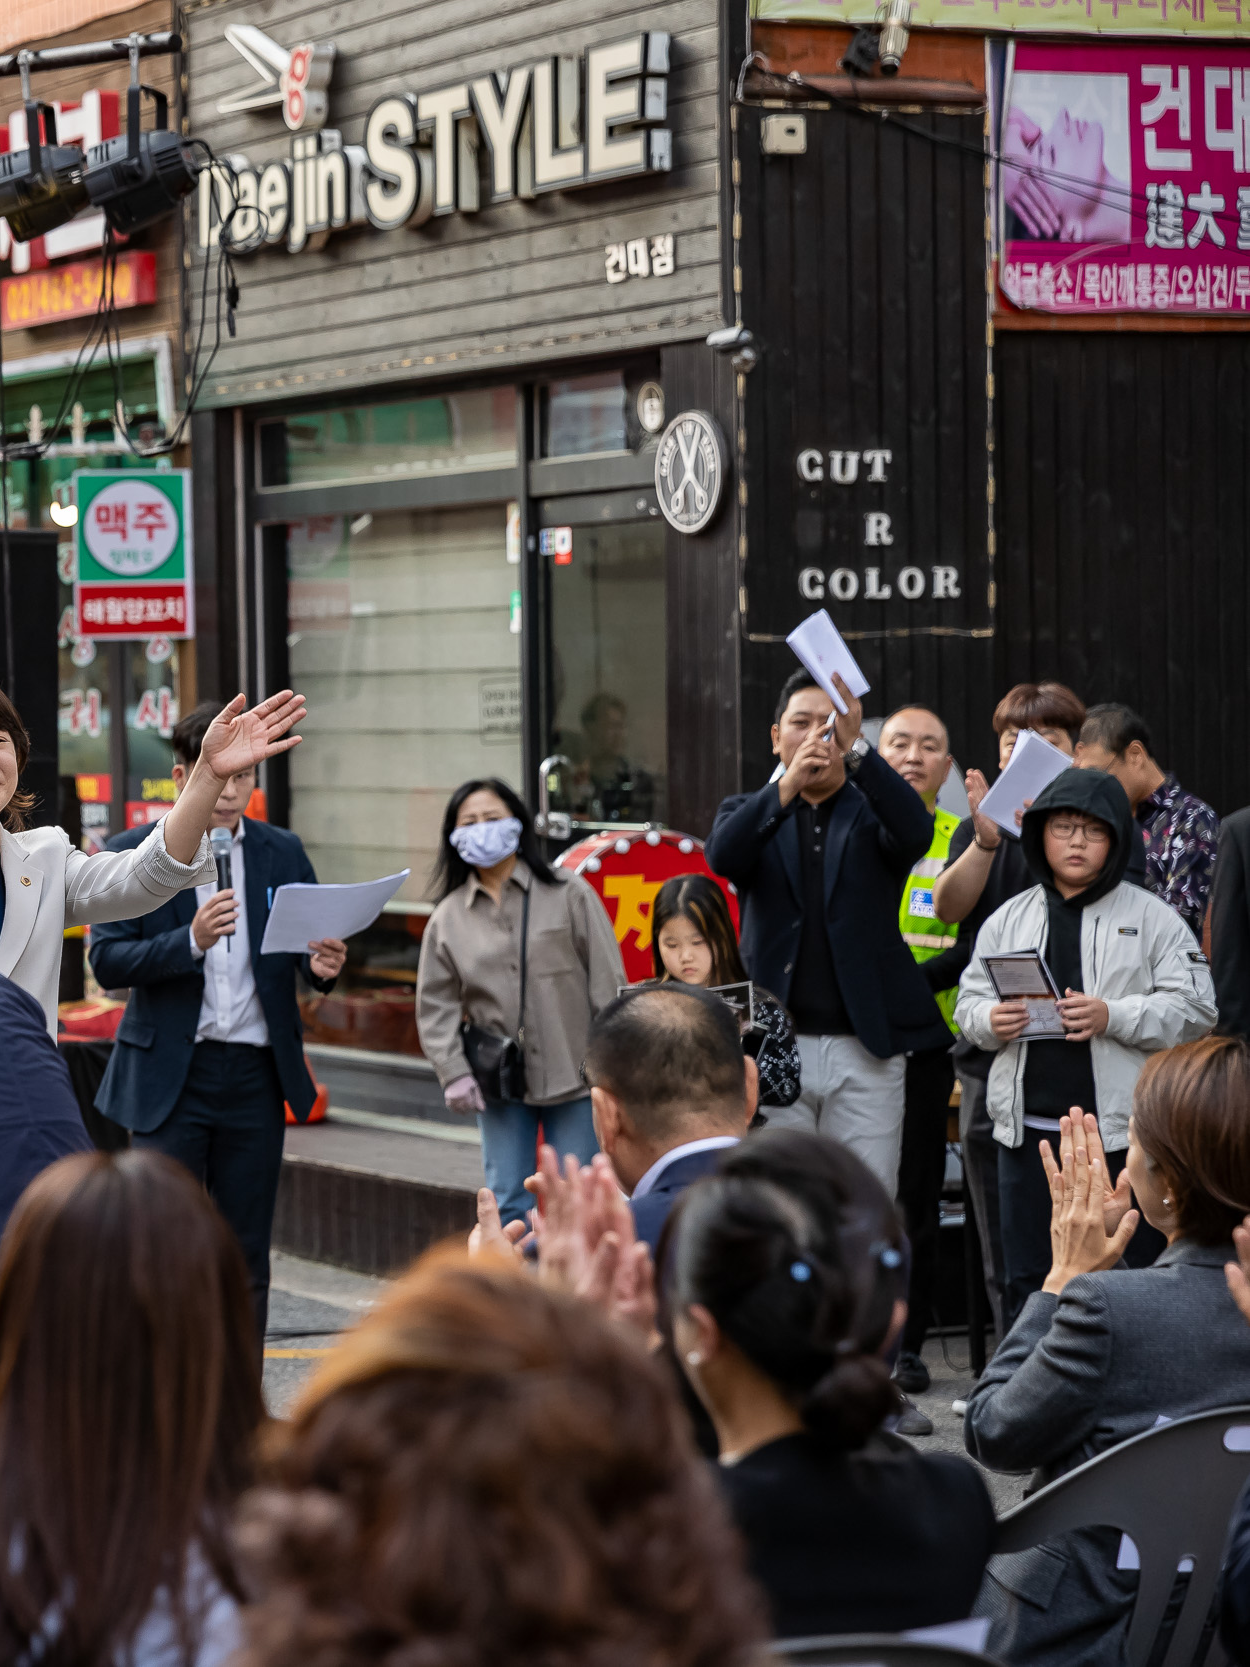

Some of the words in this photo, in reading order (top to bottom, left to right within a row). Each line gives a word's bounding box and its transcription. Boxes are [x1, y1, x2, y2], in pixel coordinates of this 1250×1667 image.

[1140, 64, 1250, 173] 건대
[198, 132, 349, 254] Daejin
[365, 32, 649, 231] STYLE
[605, 233, 674, 284] 건대점
[796, 448, 893, 484] CUT
[94, 501, 168, 542] 맥주
[797, 564, 962, 600] COLOR
